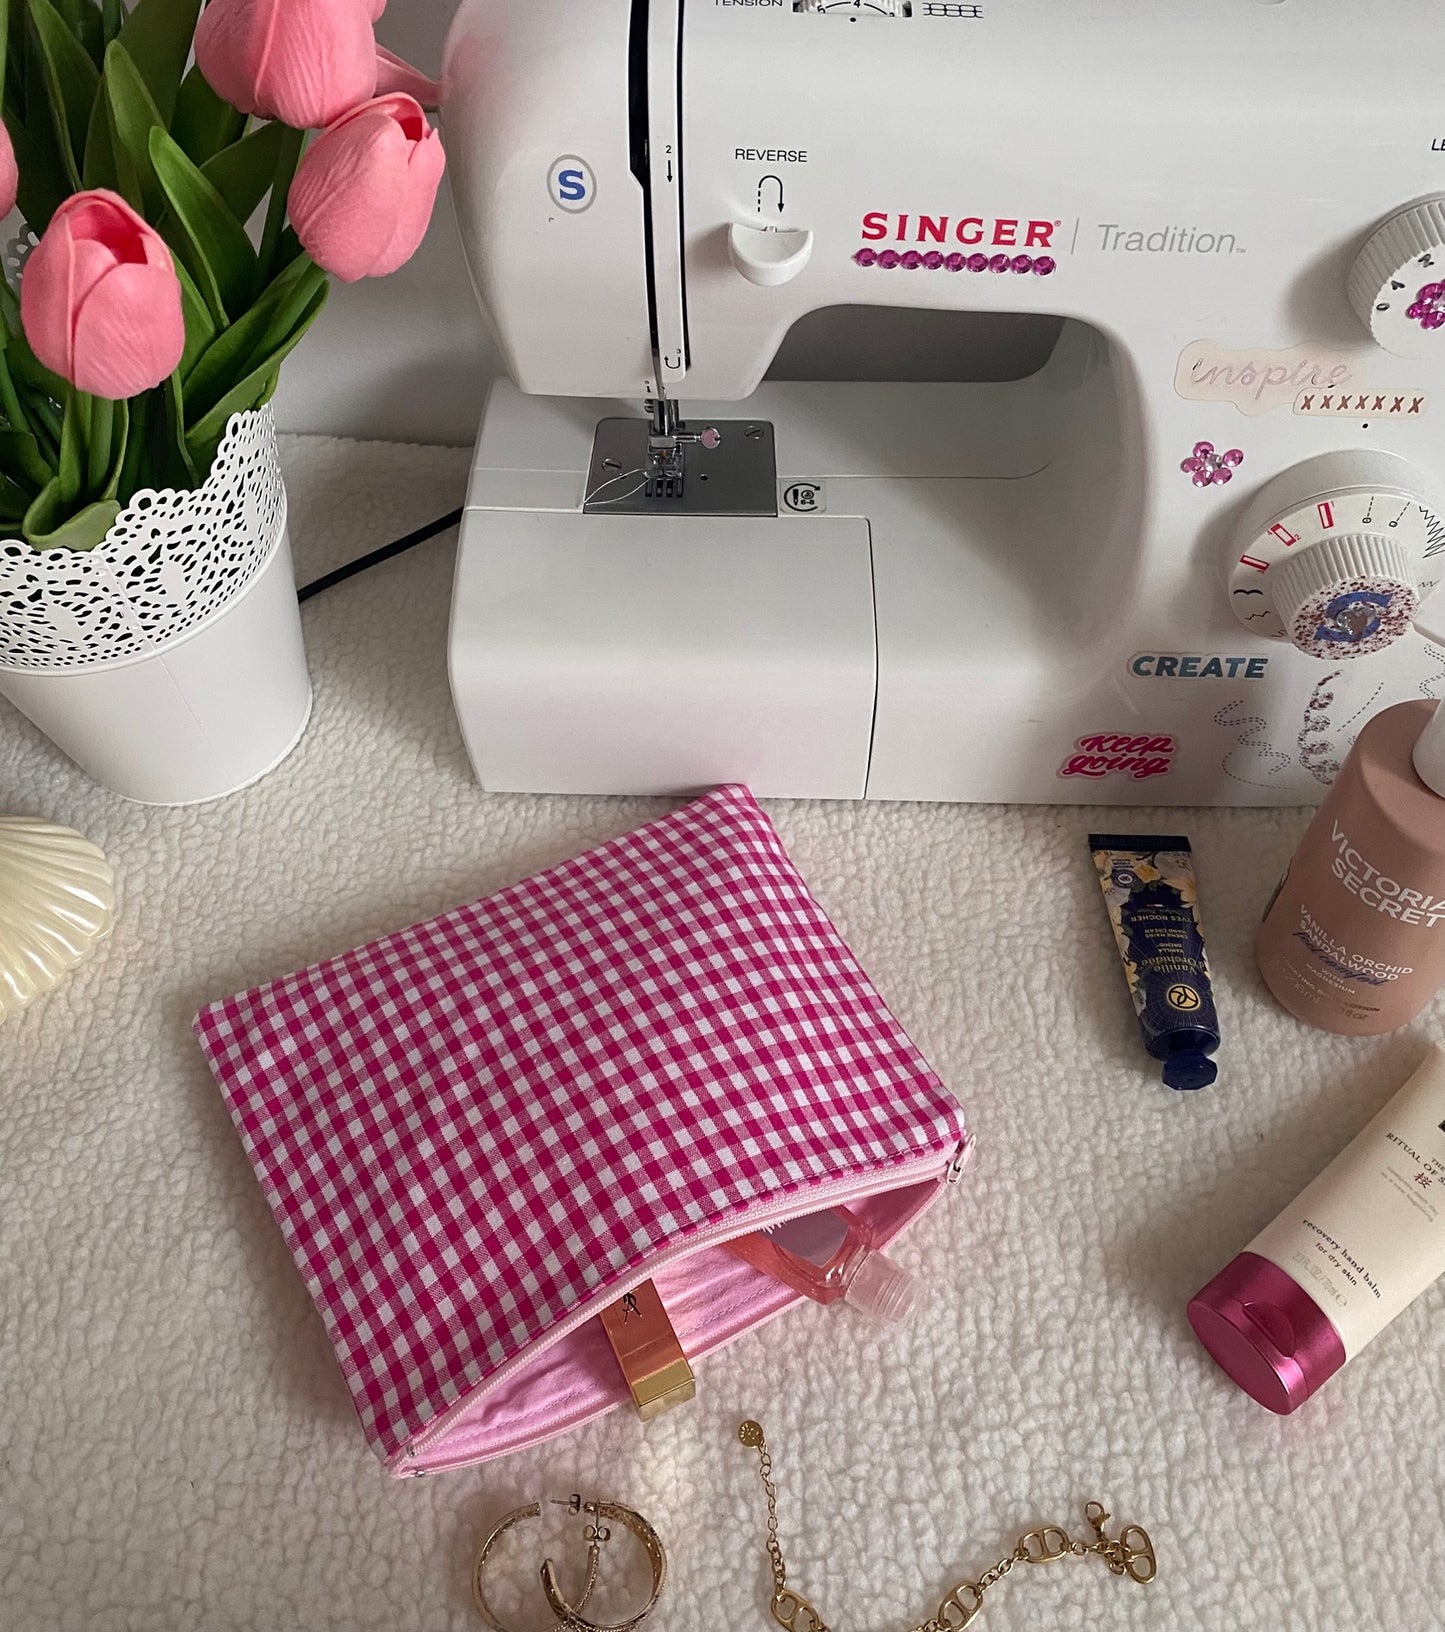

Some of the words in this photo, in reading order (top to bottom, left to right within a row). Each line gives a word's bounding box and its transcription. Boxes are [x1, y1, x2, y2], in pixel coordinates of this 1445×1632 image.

[817, 5, 826, 14] 5
[665, 145, 672, 154] 2
[735, 148, 808, 162] REVERSE
[558, 169, 586, 201] S
[1191, 358, 1352, 400] inspire
[1132, 656, 1269, 678] CREATE
[1062, 753, 1171, 778] going
[1332, 857, 1445, 928] SECRET
[1299, 919, 1399, 981] SANDALWOOD
[1301, 904, 1347, 955] VANILLA
[1352, 954, 1413, 975] ORCHID
[1386, 1132, 1421, 1163] RITUAL
[1423, 1163, 1439, 1176] OF
[1302, 1219, 1340, 1250] recovery
[1341, 1248, 1364, 1273] hand
[1363, 1272, 1381, 1299] balm
[1315, 1242, 1328, 1254] for
[1328, 1254, 1341, 1268] dry
[1342, 1268, 1357, 1286] skin
